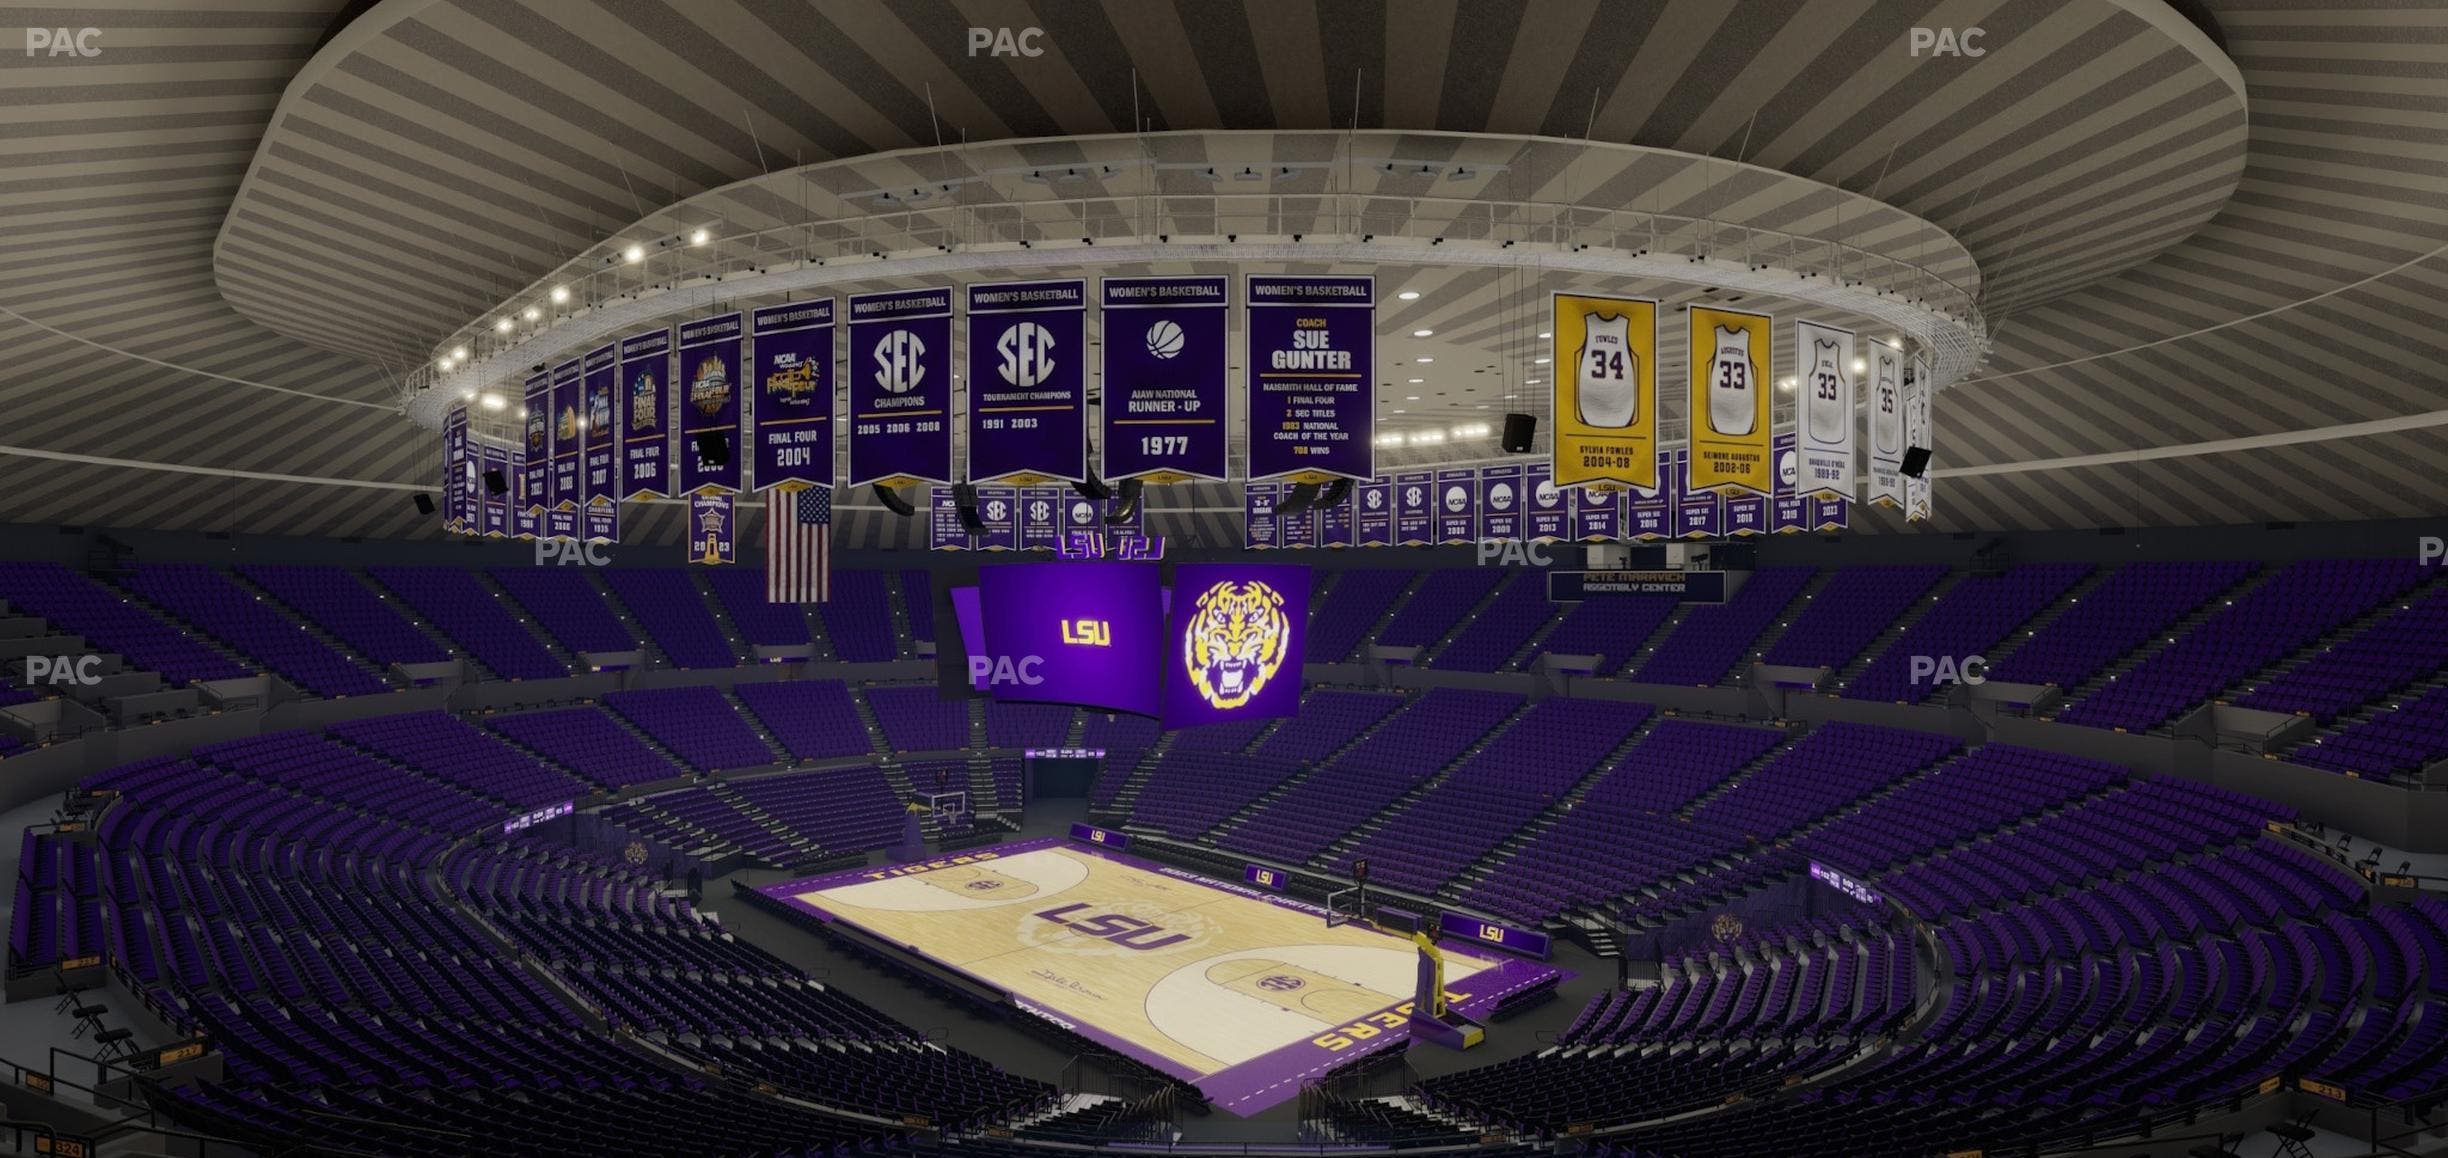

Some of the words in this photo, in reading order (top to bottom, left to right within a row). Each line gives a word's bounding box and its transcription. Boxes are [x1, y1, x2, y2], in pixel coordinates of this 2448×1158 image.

[974, 291, 1019, 304] WOMEN'S
[1020, 288, 1078, 302] BASKETBALL
[1109, 286, 1157, 297] WOMEN'S
[1159, 285, 1221, 297] BASKETBALL
[1255, 285, 1303, 296] WOMEN'S
[1305, 285, 1367, 297] BASKETBALL
[854, 301, 893, 314] WOMEN'S
[895, 297, 946, 311] BASKETBALL
[1296, 318, 1327, 328] COACH
[1293, 329, 1329, 349] SUE
[1596, 335, 1618, 345] FOWLES
[996, 321, 1056, 387] SEC
[1271, 350, 1351, 370] GUNTER
[873, 329, 926, 393] SEC
[1591, 350, 1624, 380] 34
[1720, 361, 1745, 389] 33
[1303, 383, 1323, 392] HALL
[1324, 384, 1335, 392] OF
[1336, 383, 1358, 392] FAME
[1818, 372, 1836, 401] 33
[1029, 390, 1072, 401] CHAMPIONS
[1131, 389, 1154, 400] AIAW
[1155, 389, 1198, 399] NATIONAL
[1293, 396, 1313, 405] FINAL
[1314, 396, 1335, 405] FOUR
[1881, 387, 1893, 414] 35
[874, 396, 925, 409] CHAMPIONS
[1128, 400, 1176, 413] RUNNER
[1184, 400, 1202, 412] UP
[1295, 409, 1310, 418] SEC
[857, 424, 880, 435] 2005
[982, 419, 1004, 429] 1991
[1011, 418, 1038, 429] 2003
[1303, 422, 1339, 431] NATIONAL
[768, 433, 792, 445] FINAL
[794, 430, 817, 443] FOUR
[1273, 432, 1298, 441] COACH
[1301, 432, 1312, 441] OF
[1313, 432, 1328, 441] THE
[1329, 432, 1349, 441] YEAR
[629, 449, 644, 460] FINAL
[645, 445, 660, 457] FOUR
[1141, 436, 1189, 456] 1977
[1310, 446, 1330, 455] WINS
[1579, 445, 1604, 455] SYLVIA
[1606, 446, 1634, 455] FOWLES
[777, 447, 811, 467] 2004
[1583, 456, 1630, 468] 2004-08
[1713, 462, 1751, 474] 2002-06
[1641, 583, 1686, 592] CENTER
[1061, 619, 1111, 647] LSU
[1091, 829, 1106, 842] LSU
[1256, 868, 1274, 885] LSU
[1034, 903, 1192, 951] LSU
[1479, 924, 1505, 943] LSU
[56, 1142, 80, 1155] 324
